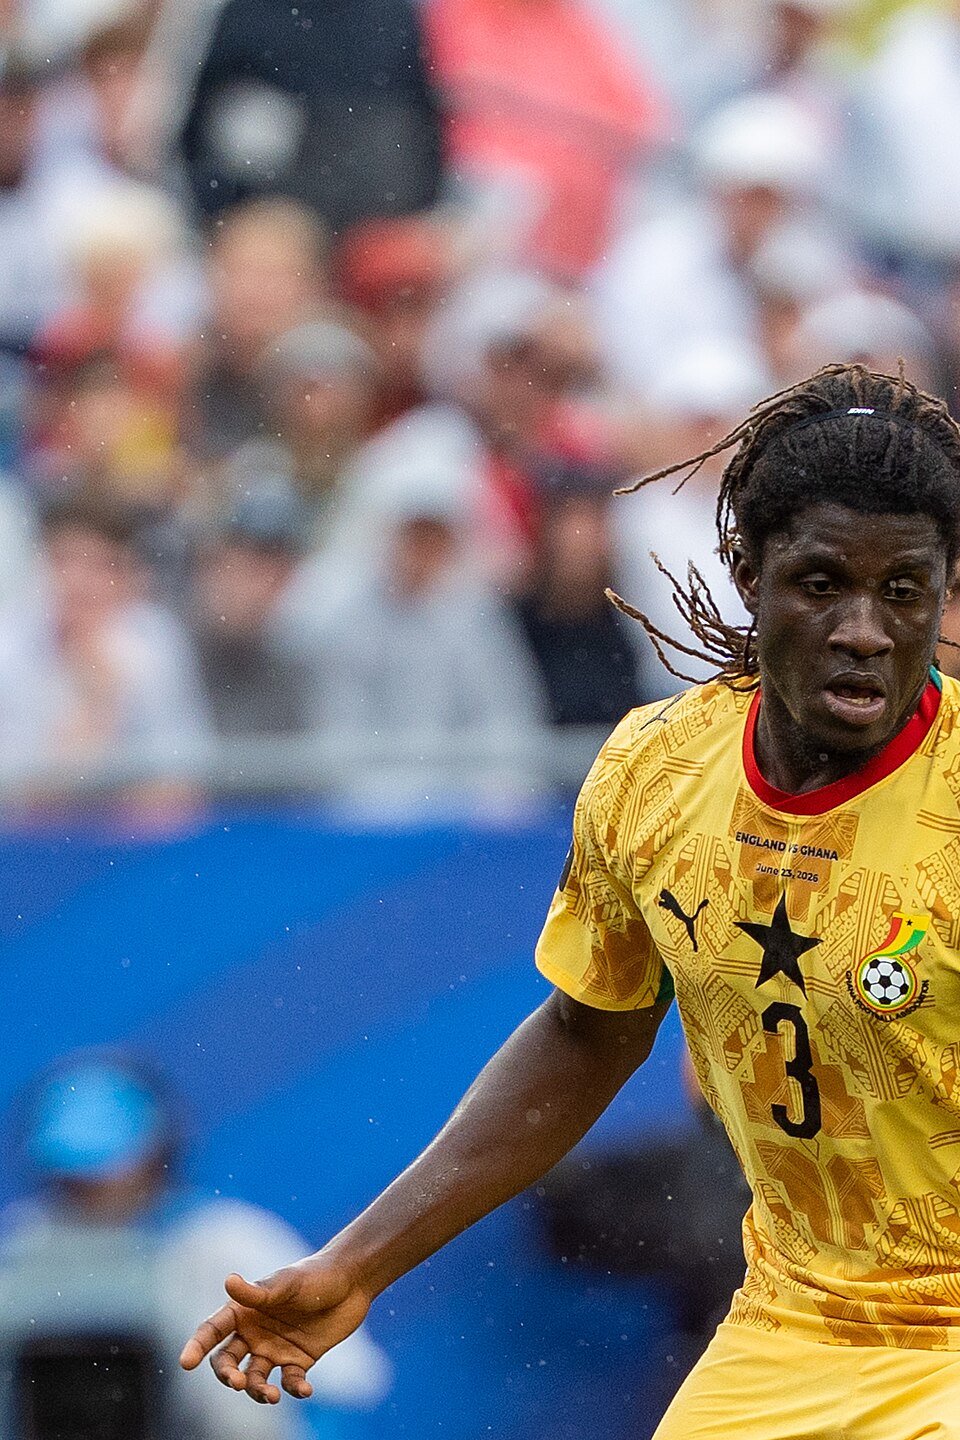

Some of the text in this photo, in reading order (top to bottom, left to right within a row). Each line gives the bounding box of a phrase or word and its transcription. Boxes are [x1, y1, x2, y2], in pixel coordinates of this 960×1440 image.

[735, 831, 787, 852] ENGLAND
[800, 845, 839, 861] GHANA
[756, 863, 779, 876] June
[797, 870, 819, 883] 2026
[761, 1001, 822, 1139] 3
